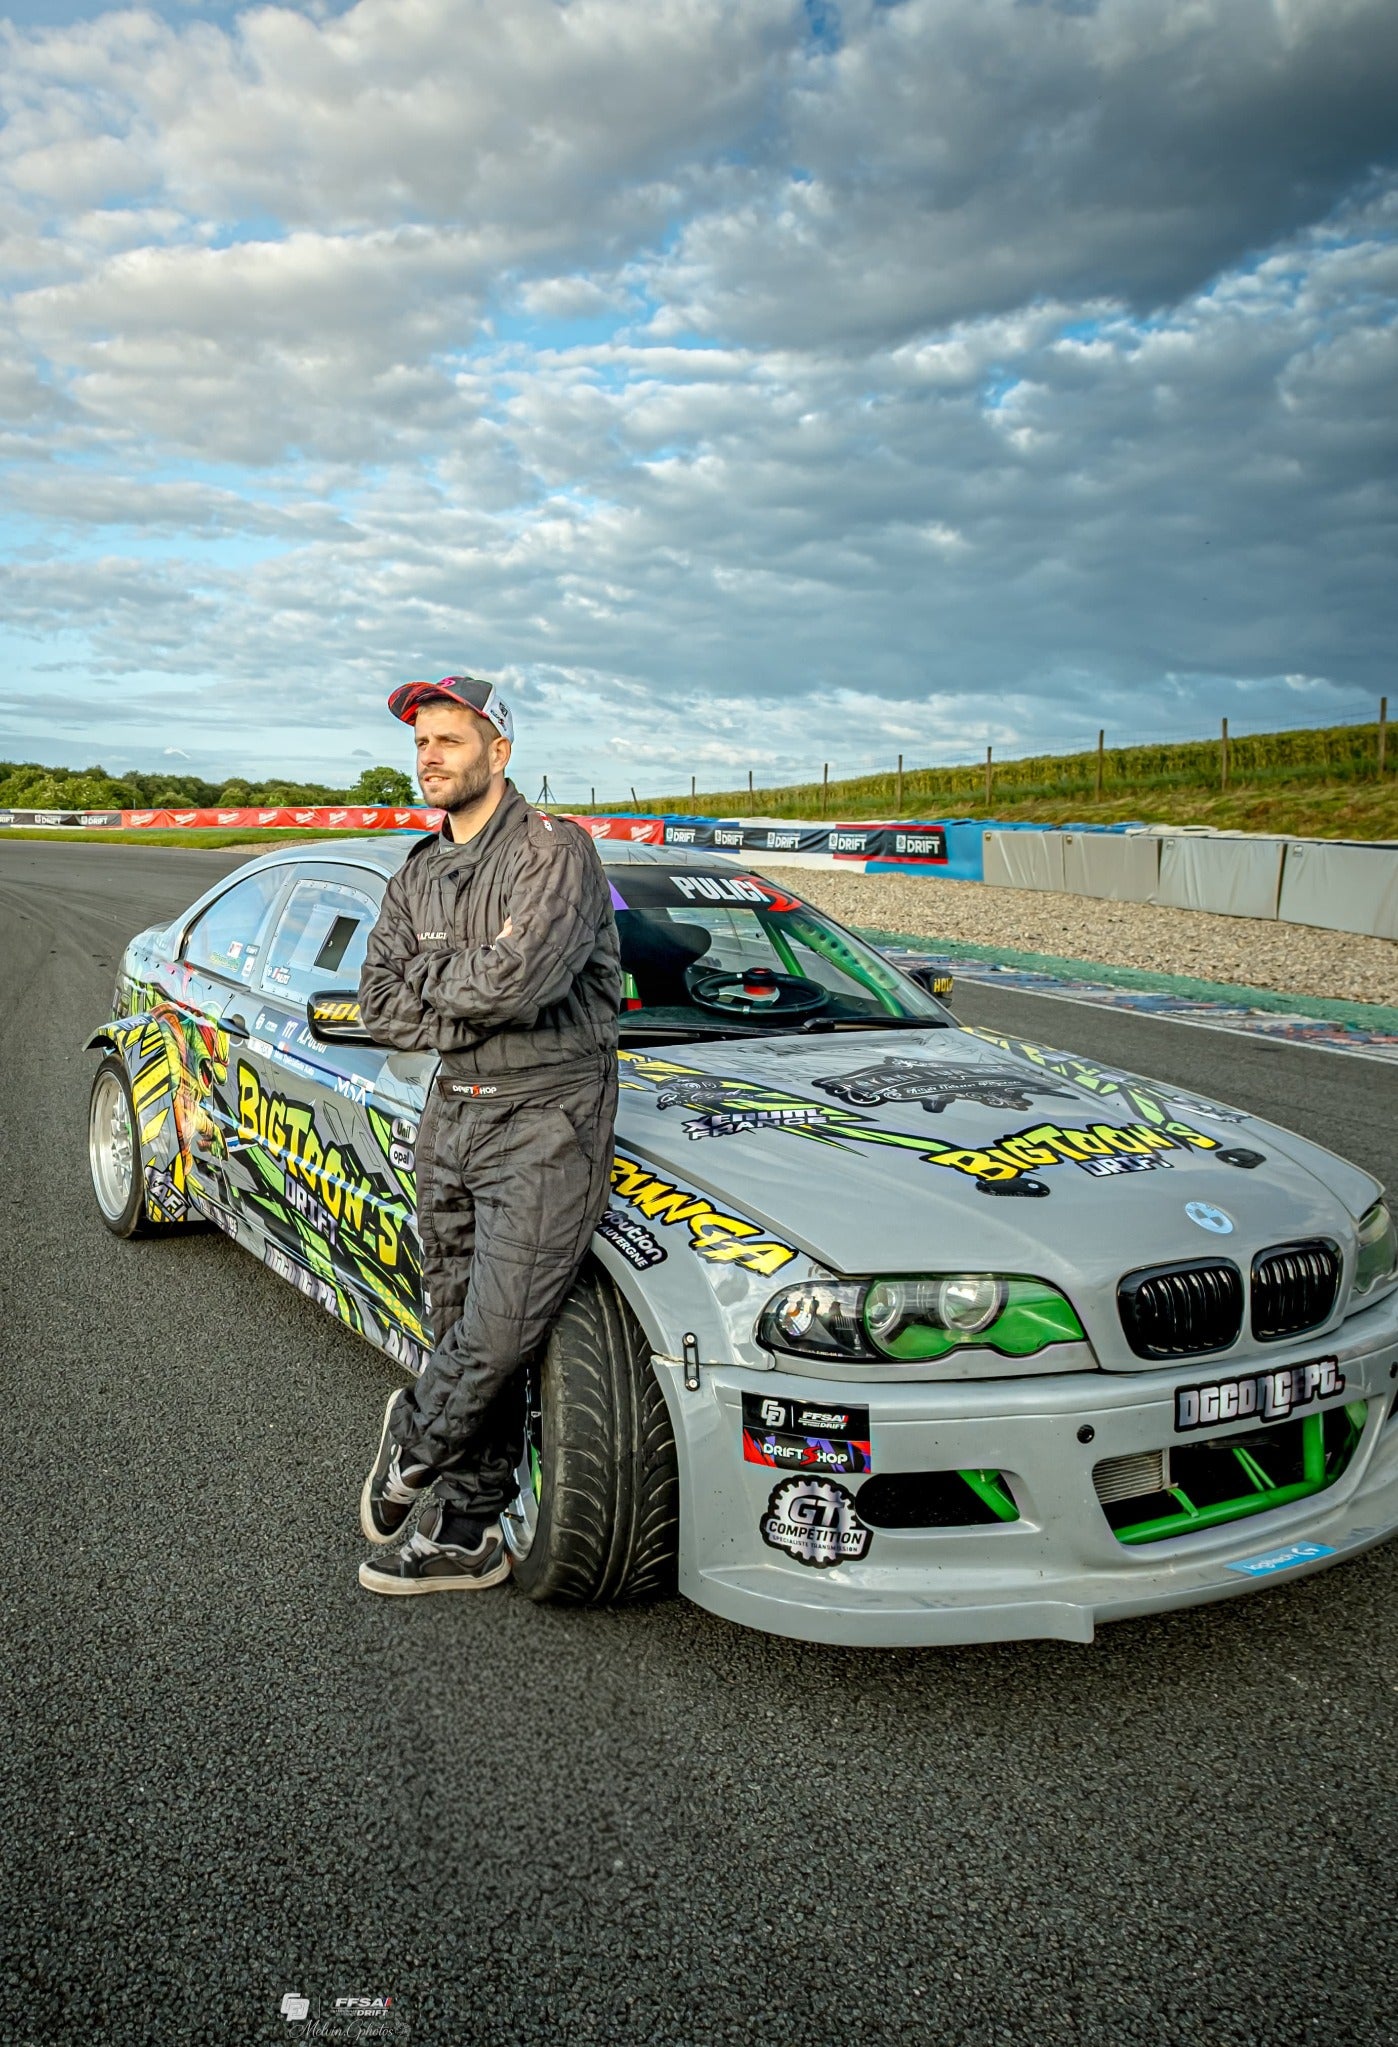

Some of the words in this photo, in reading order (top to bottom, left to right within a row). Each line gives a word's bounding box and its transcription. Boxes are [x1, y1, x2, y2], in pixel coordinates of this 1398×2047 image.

[673, 832, 695, 843] DRIFT
[722, 834, 744, 846] DRIFT
[775, 836, 800, 849] DRIFT
[838, 837, 867, 851] DRIFT
[907, 840, 940, 854] DRIFT
[669, 876, 771, 903] PULICI
[691, 1116, 827, 1140] FRANCE
[393, 1150, 410, 1165] opal
[1080, 1154, 1171, 1176] DRIFT
[285, 1174, 339, 1246] DRIFT
[599, 1226, 648, 1268] AUVERGNE
[802, 1411, 842, 1422] FFSA
[820, 1422, 847, 1430] DRIFT
[763, 1443, 848, 1467] DRIFTSHOP
[789, 1497, 846, 1528] GT
